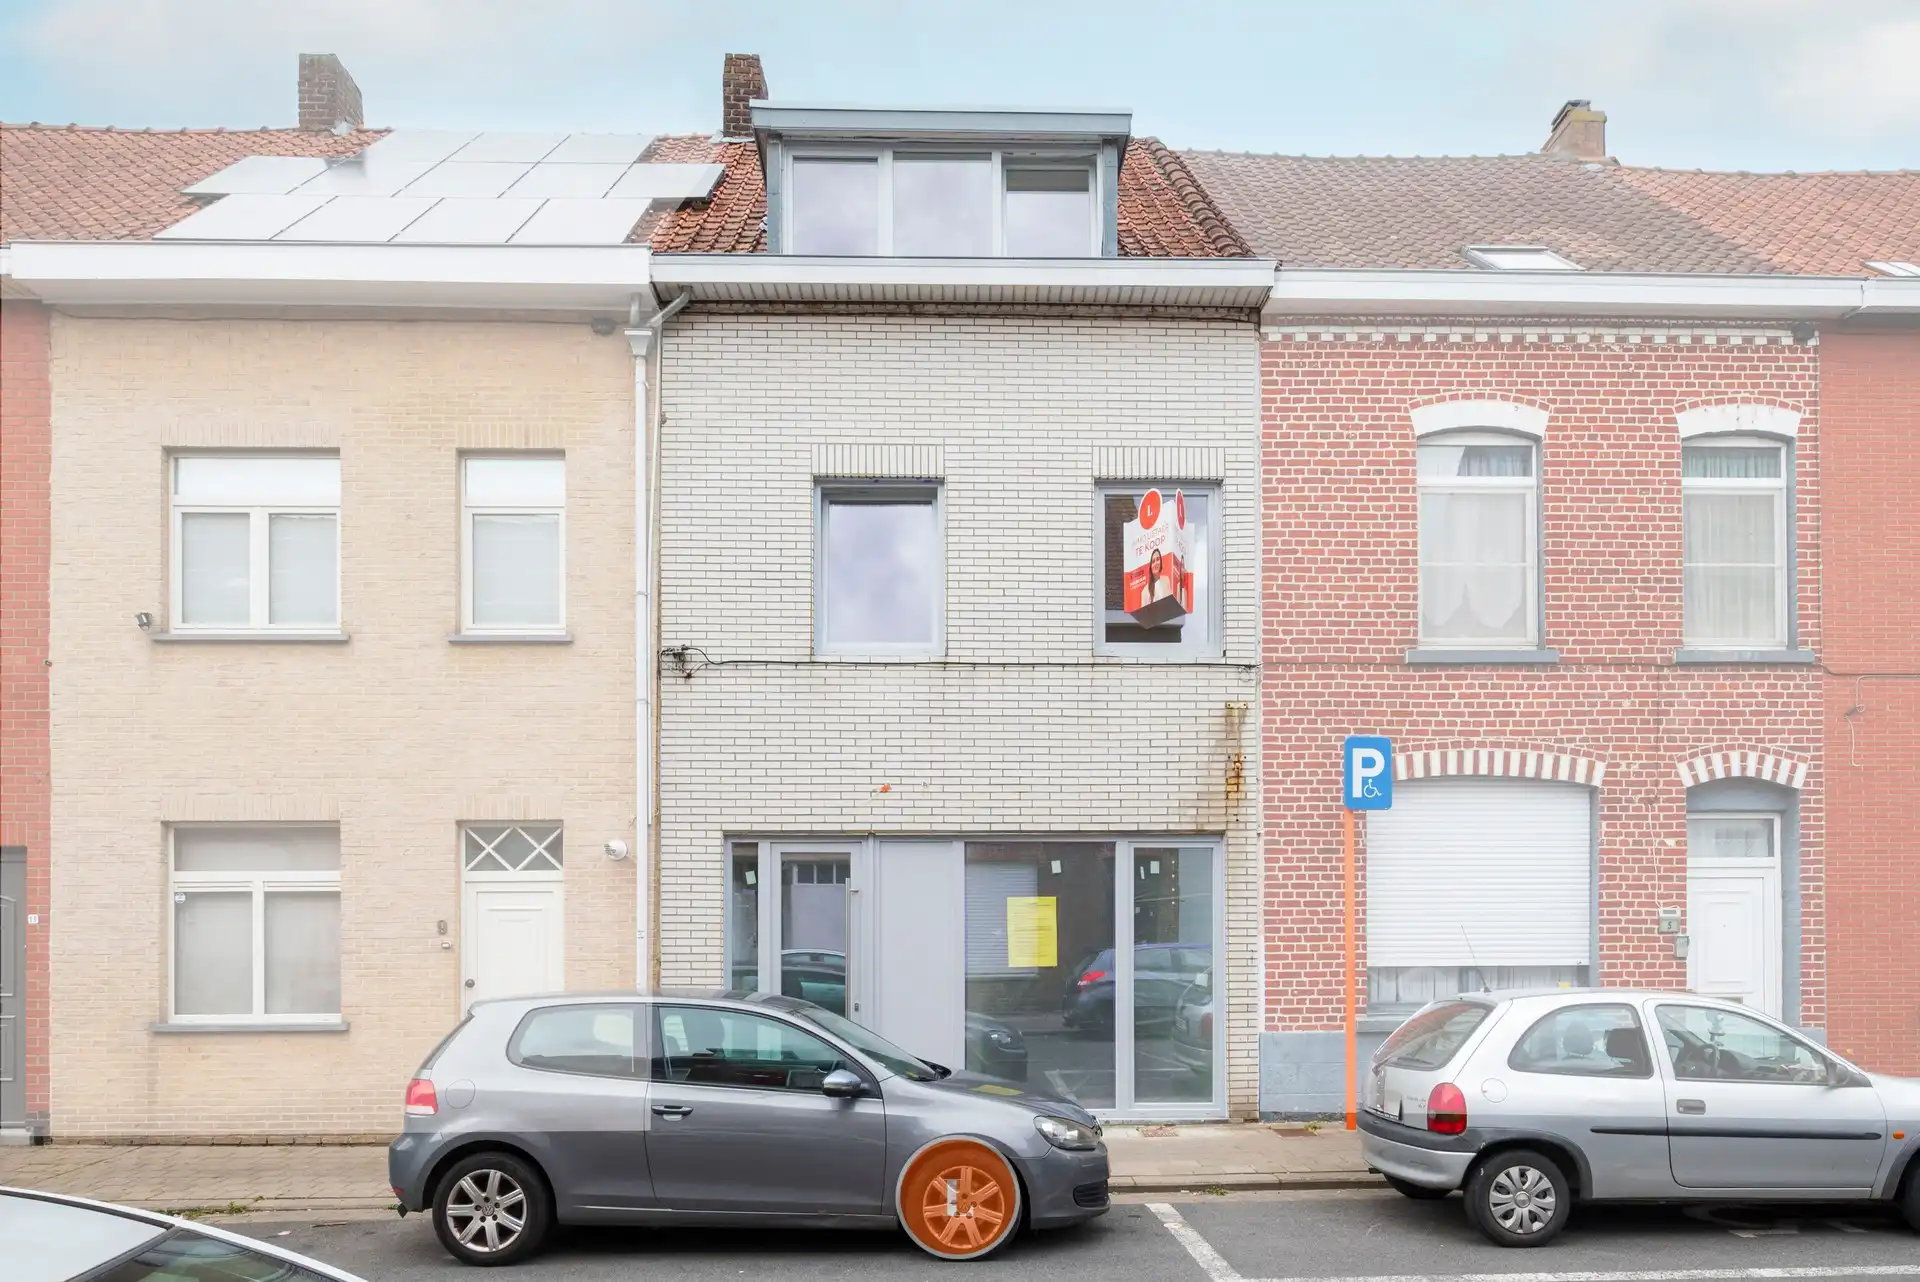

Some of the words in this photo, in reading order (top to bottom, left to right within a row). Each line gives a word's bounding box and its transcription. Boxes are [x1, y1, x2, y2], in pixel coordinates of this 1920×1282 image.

[1135, 545, 1145, 557] TE
[1145, 534, 1166, 553] KOOP
[1352, 748, 1385, 798] P
[1667, 921, 1672, 930] 5
